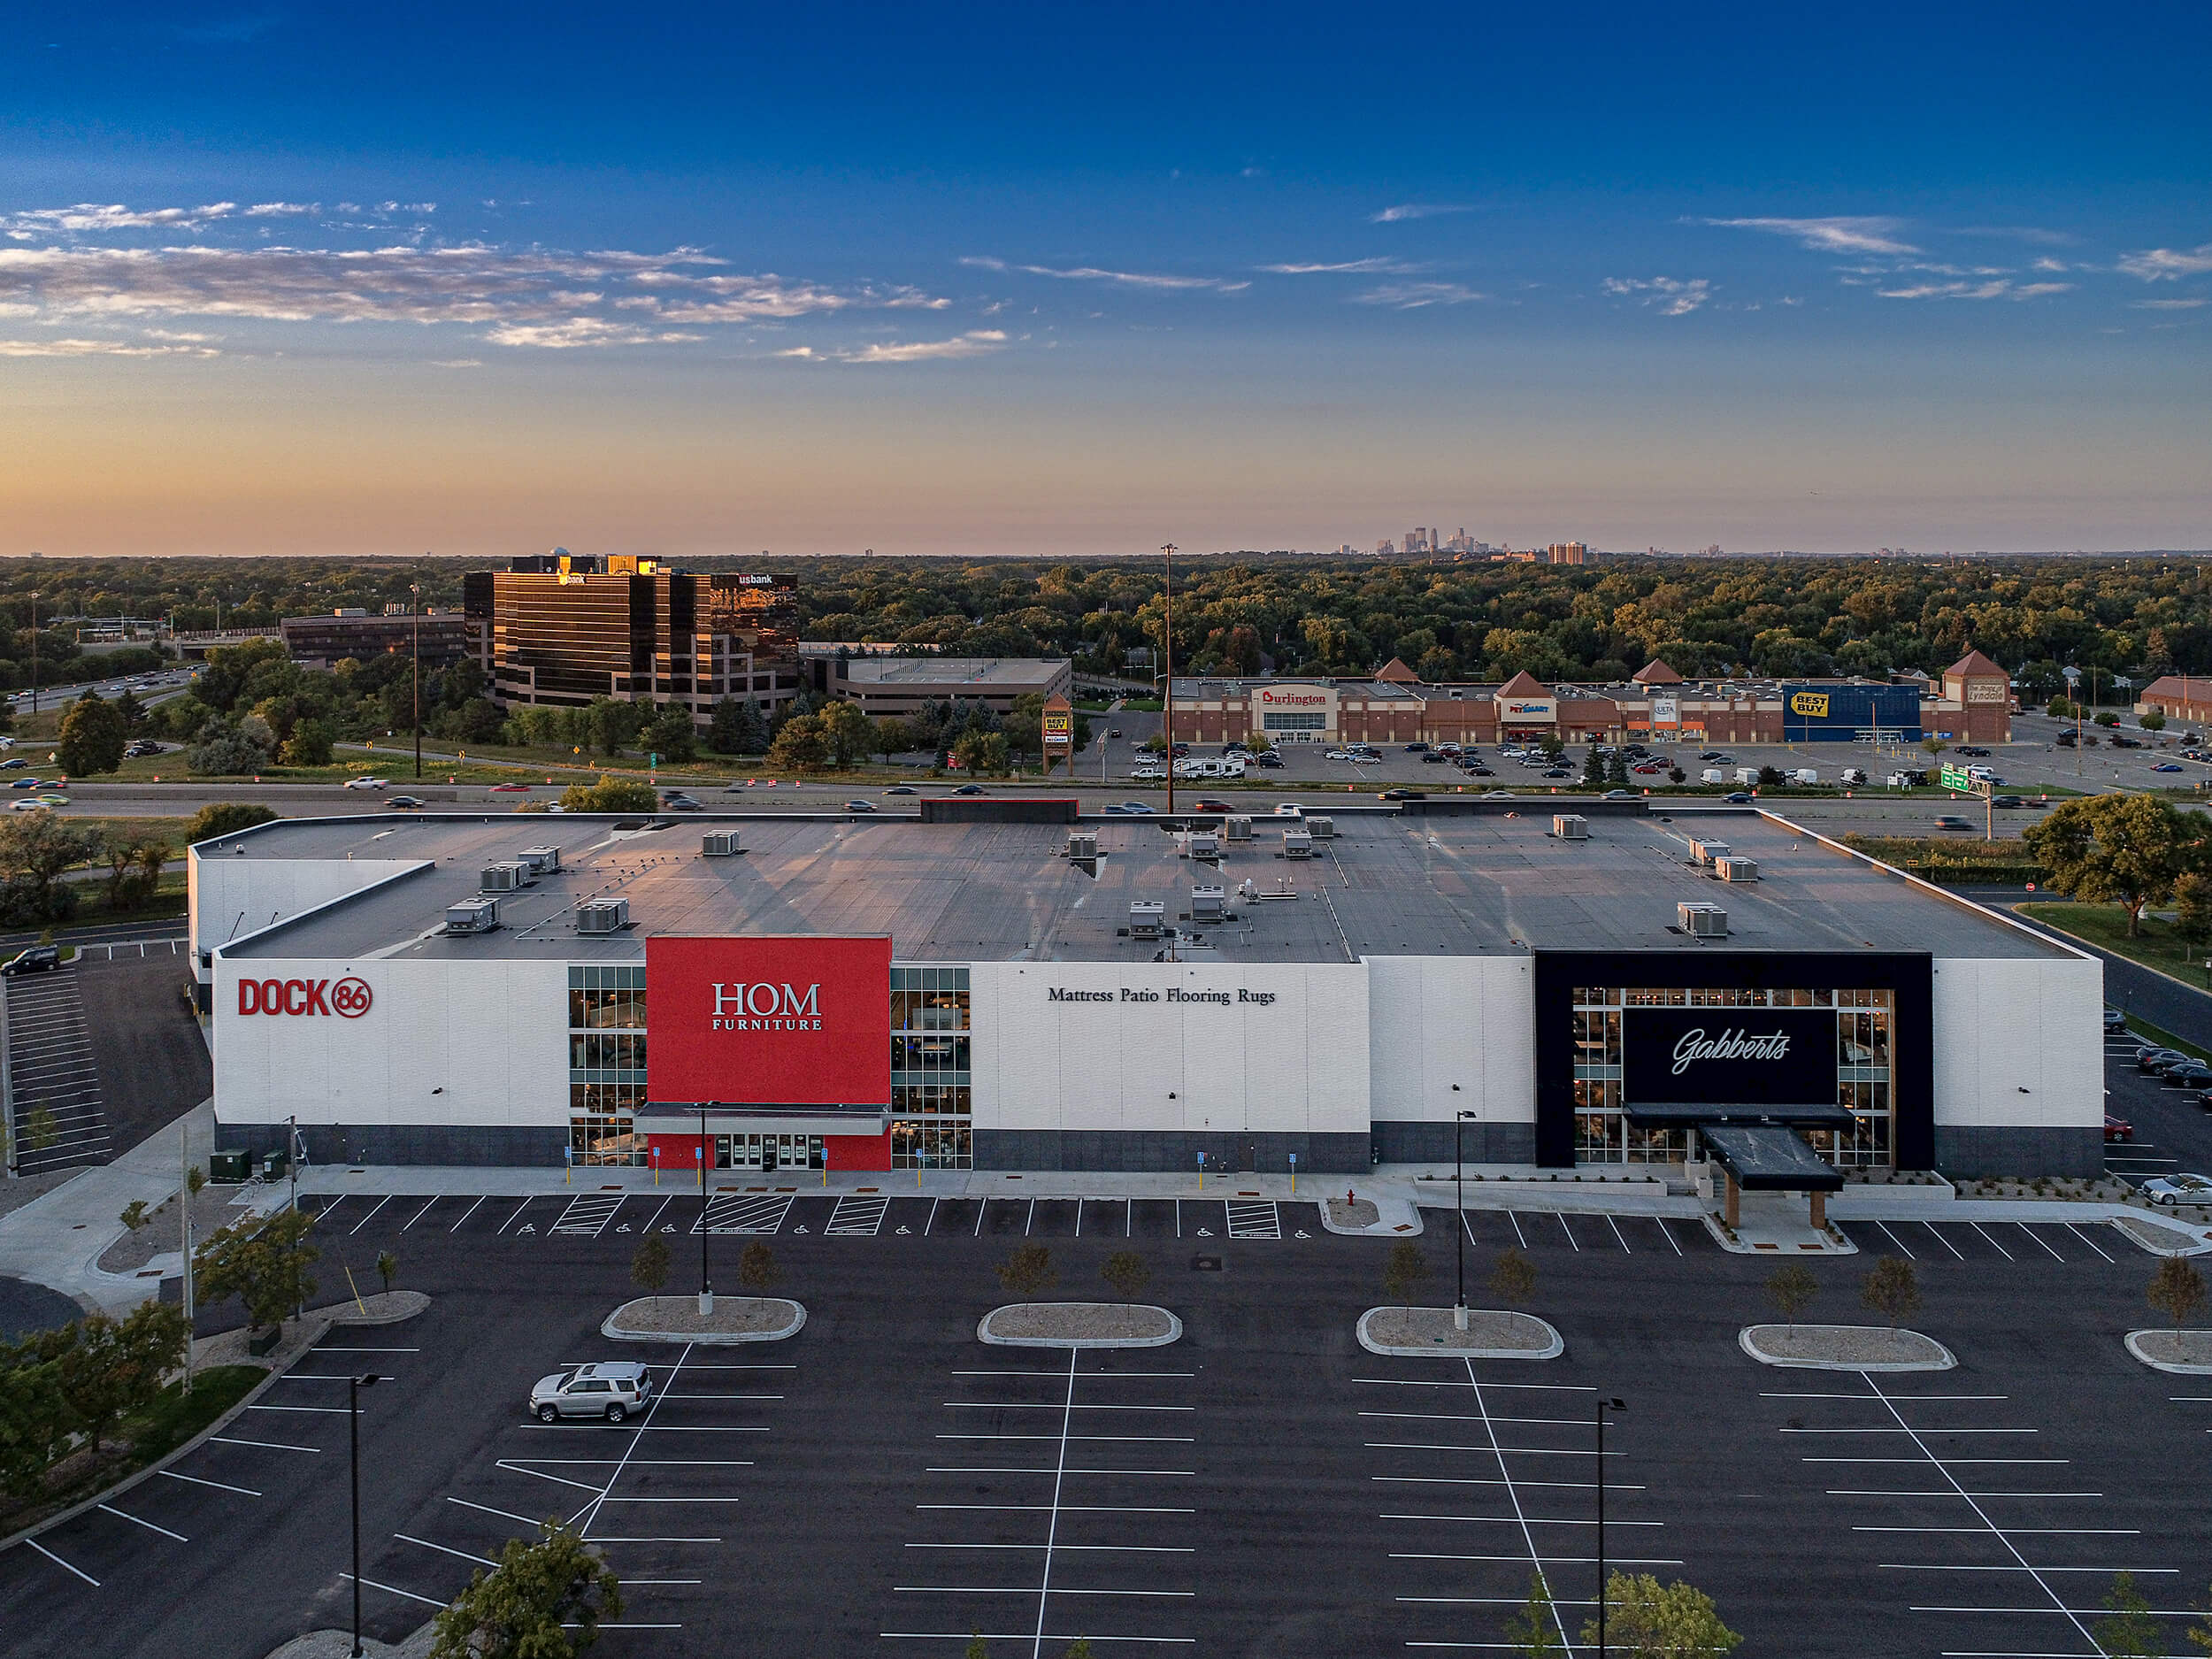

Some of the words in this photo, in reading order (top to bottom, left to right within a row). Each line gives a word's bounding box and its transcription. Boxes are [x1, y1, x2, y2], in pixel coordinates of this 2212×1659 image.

[1263, 691, 1326, 706] Burlington
[1797, 696, 1827, 705] BEST
[1969, 691, 2003, 701] Lyndale
[238, 979, 331, 1016] DOCK
[711, 982, 822, 1017] HOM
[1048, 987, 1114, 1002] Mattress
[1120, 987, 1159, 1002] Patio
[1166, 987, 1231, 1005] Flooring
[1238, 988, 1275, 1005] Rugs
[712, 1019, 822, 1031] FURNITURE
[1671, 1028, 1791, 1075] Gabberts
